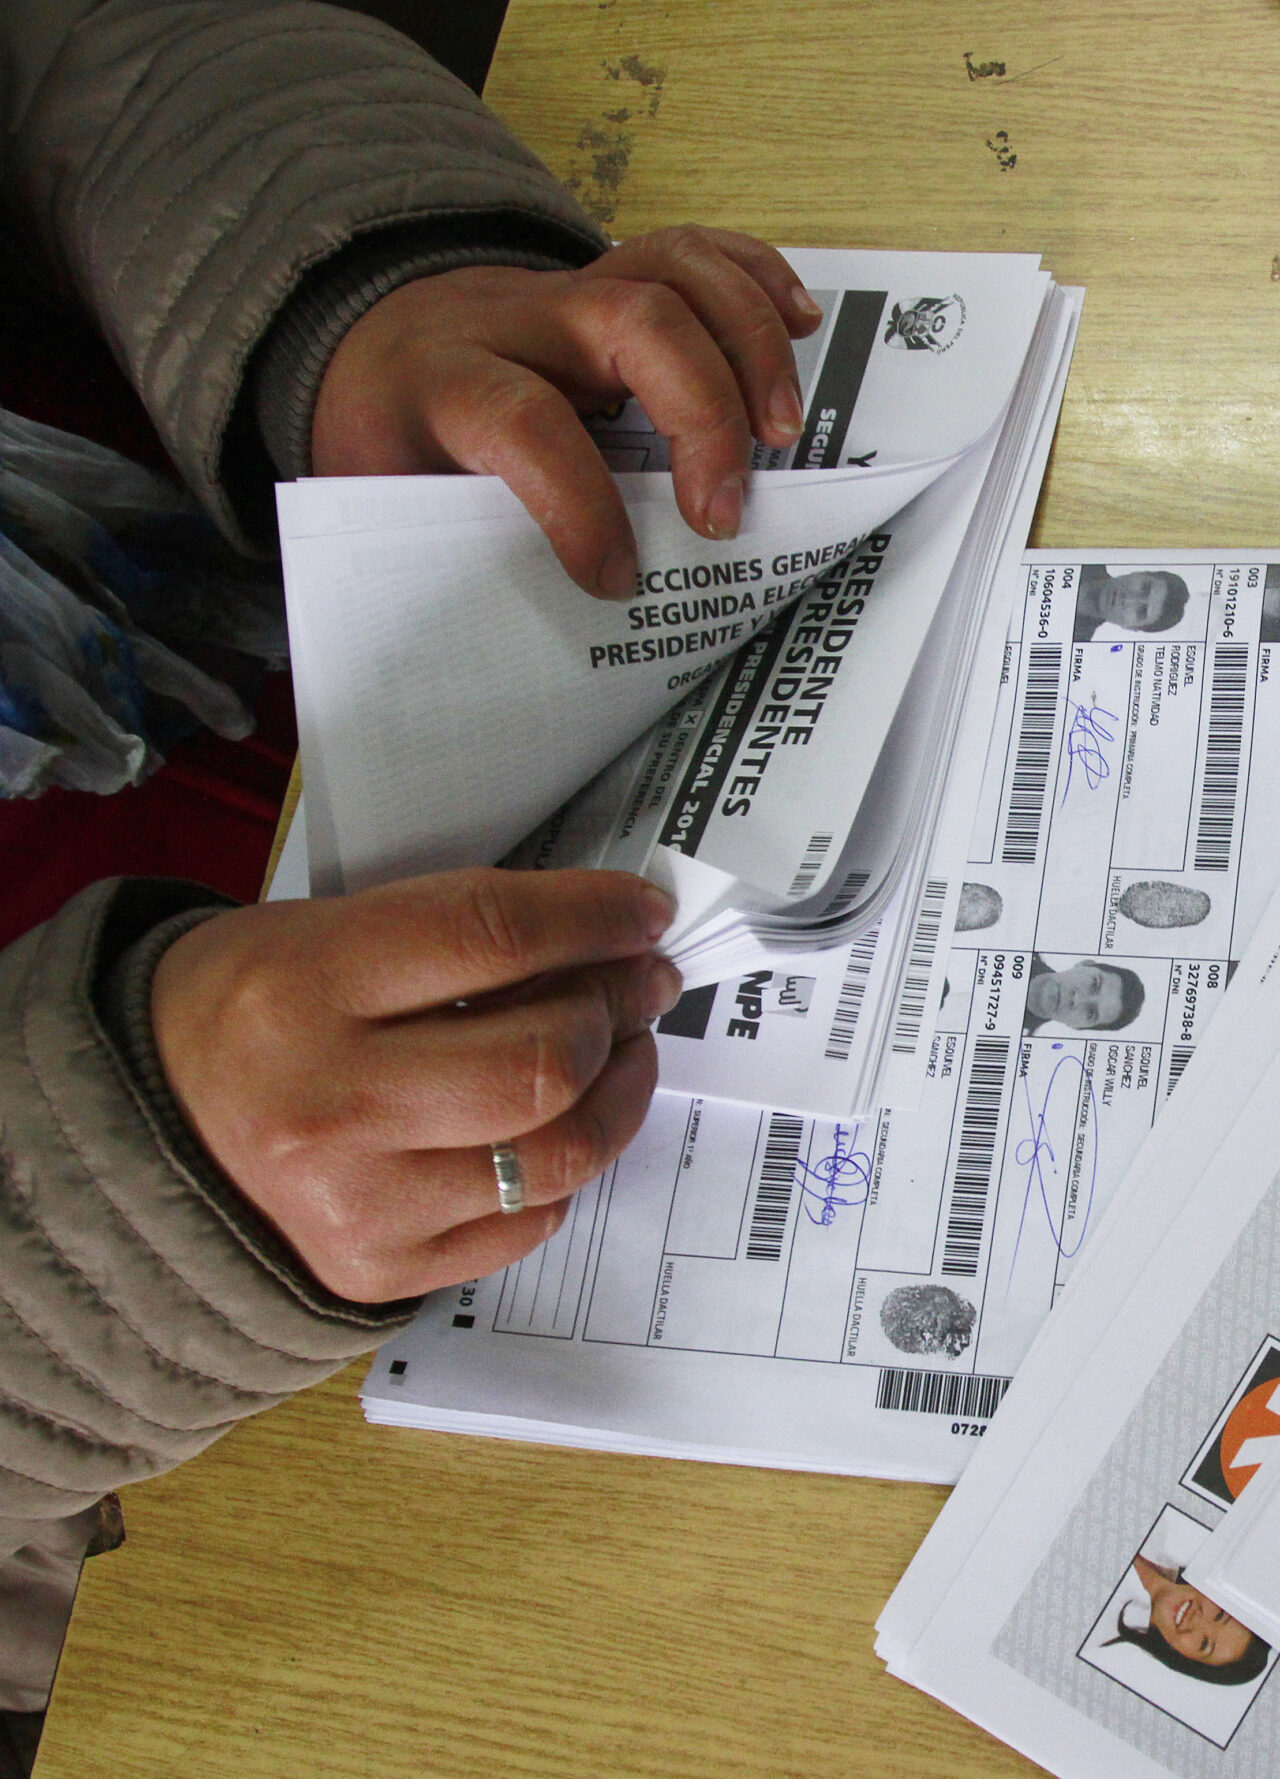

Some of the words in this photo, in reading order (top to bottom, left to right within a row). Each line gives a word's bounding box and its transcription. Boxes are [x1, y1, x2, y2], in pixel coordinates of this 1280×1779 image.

[847, 451, 877, 467] Y
[1028, 579, 1038, 596] DNI
[1062, 568, 1074, 589] 004
[1213, 580, 1222, 595] DNI
[1247, 567, 1259, 588] 003
[627, 592, 756, 630] SEGUNDA
[1038, 569, 1055, 638] 10604536-0
[1223, 568, 1240, 638] 19101210-6
[589, 622, 742, 668] PRESIDENTE
[780, 534, 891, 745] PRESIDENTE
[1073, 648, 1083, 682] FIRMA
[1153, 646, 1165, 677] TELMO
[1167, 645, 1181, 696] RODRIGUEZ
[1184, 645, 1196, 687] ESQUIVEL
[1260, 648, 1271, 682] FIRMA
[688, 641, 767, 792] PRESIDENCIAL
[1149, 679, 1162, 726] NATIVIDAD
[659, 732, 688, 781] DENTRO
[618, 753, 663, 838] PREFERENCIA
[647, 784, 666, 809] DEL
[1122, 762, 1133, 799] COMPLETA
[1107, 873, 1122, 909] HUELLA
[1104, 909, 1119, 949] DACTILAR
[977, 968, 986, 985] DNI
[1012, 955, 1025, 979] 009
[1172, 977, 1181, 994] DNI
[1207, 964, 1220, 989] 008
[726, 970, 774, 1040] NPE
[985, 954, 1005, 1030] 09451727-9
[1180, 964, 1200, 1041] 32769738-8
[941, 1036, 957, 1078] ESQUIVEL
[1017, 1042, 1032, 1078] FIRMA
[1106, 1045, 1119, 1076] OSCAR
[1121, 1045, 1135, 1089] SANCHEZ
[1137, 1046, 1152, 1090] ESQUIVEL
[1102, 1078, 1114, 1107] WILLY
[877, 1121, 890, 1165] SECUNDARIA
[1069, 1132, 1087, 1179] SECUNDARIA
[870, 1167, 882, 1205] COMPLETA
[1064, 1179, 1081, 1221] COMPLETA
[459, 1287, 475, 1307] 30
[660, 1260, 674, 1296] HUELLA
[854, 1277, 867, 1311] HUELLA
[653, 1295, 668, 1340] DACTILAR
[846, 1314, 862, 1357] DACTILAR
